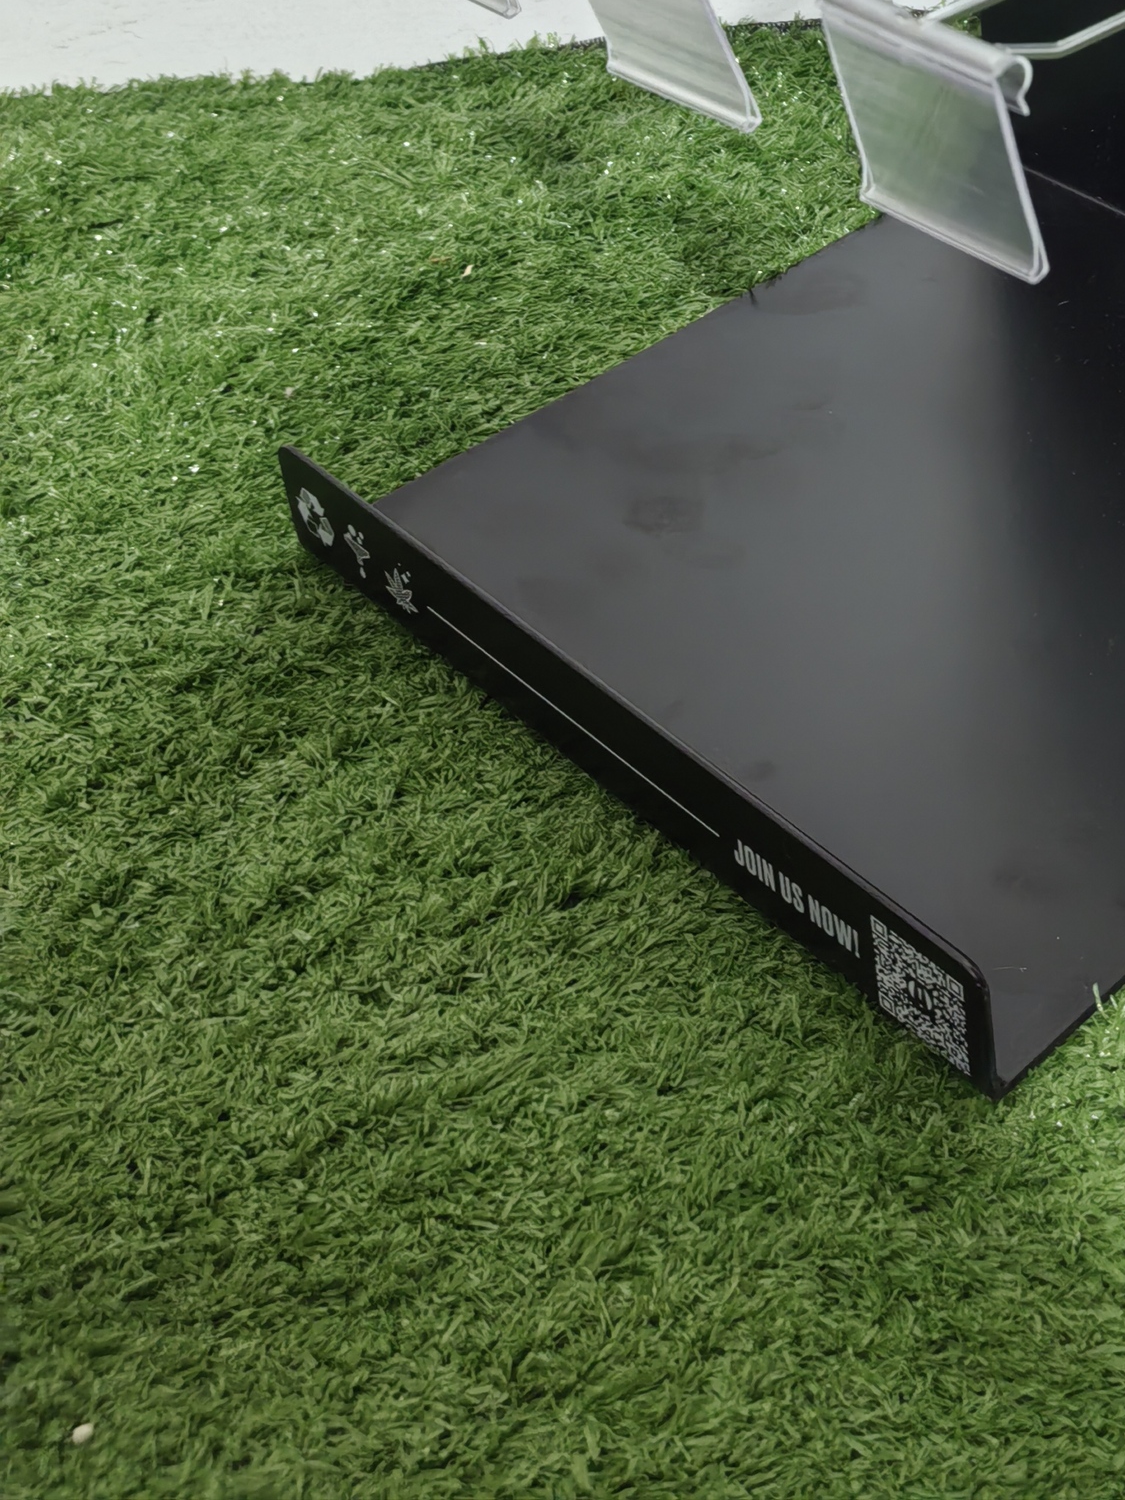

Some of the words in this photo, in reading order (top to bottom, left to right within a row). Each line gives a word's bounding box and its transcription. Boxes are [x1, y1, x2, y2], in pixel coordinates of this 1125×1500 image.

[733, 838, 776, 892] JOIN
[778, 870, 805, 914] US
[807, 894, 861, 959] NOW!
